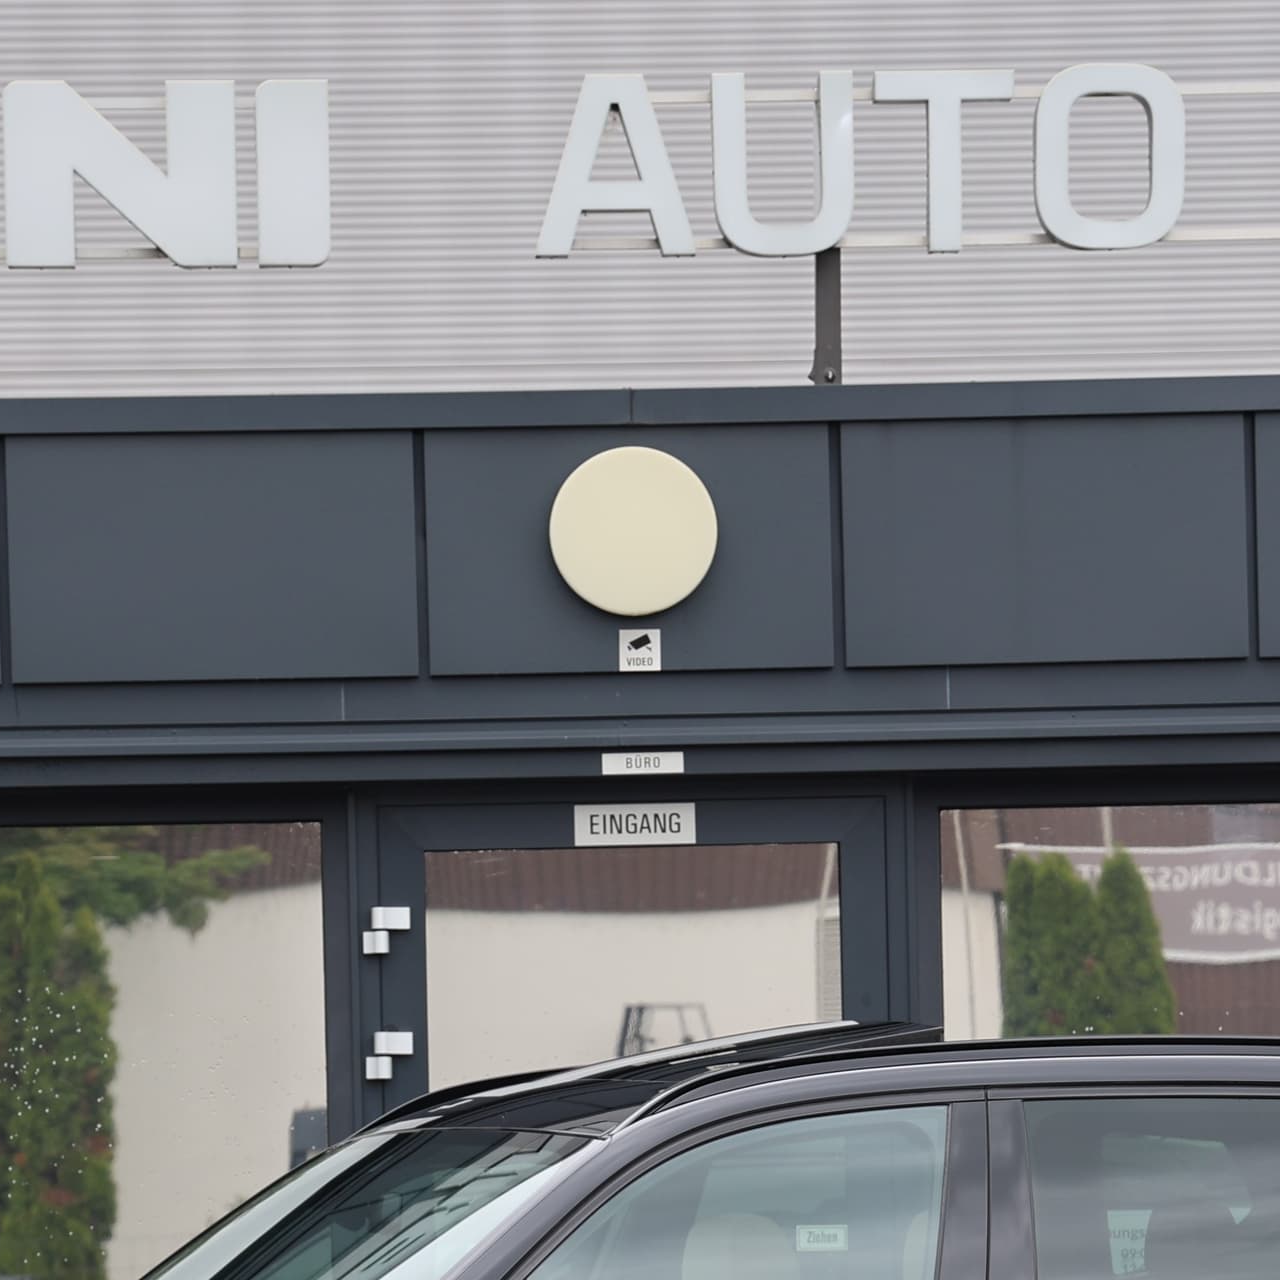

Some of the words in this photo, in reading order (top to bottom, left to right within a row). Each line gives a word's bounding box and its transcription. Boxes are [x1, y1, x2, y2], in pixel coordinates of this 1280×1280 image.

[535, 62, 1185, 259] AUTO
[626, 656, 654, 667] VIDEO
[625, 754, 661, 769] BÜRO
[589, 812, 682, 835] EINGANG
